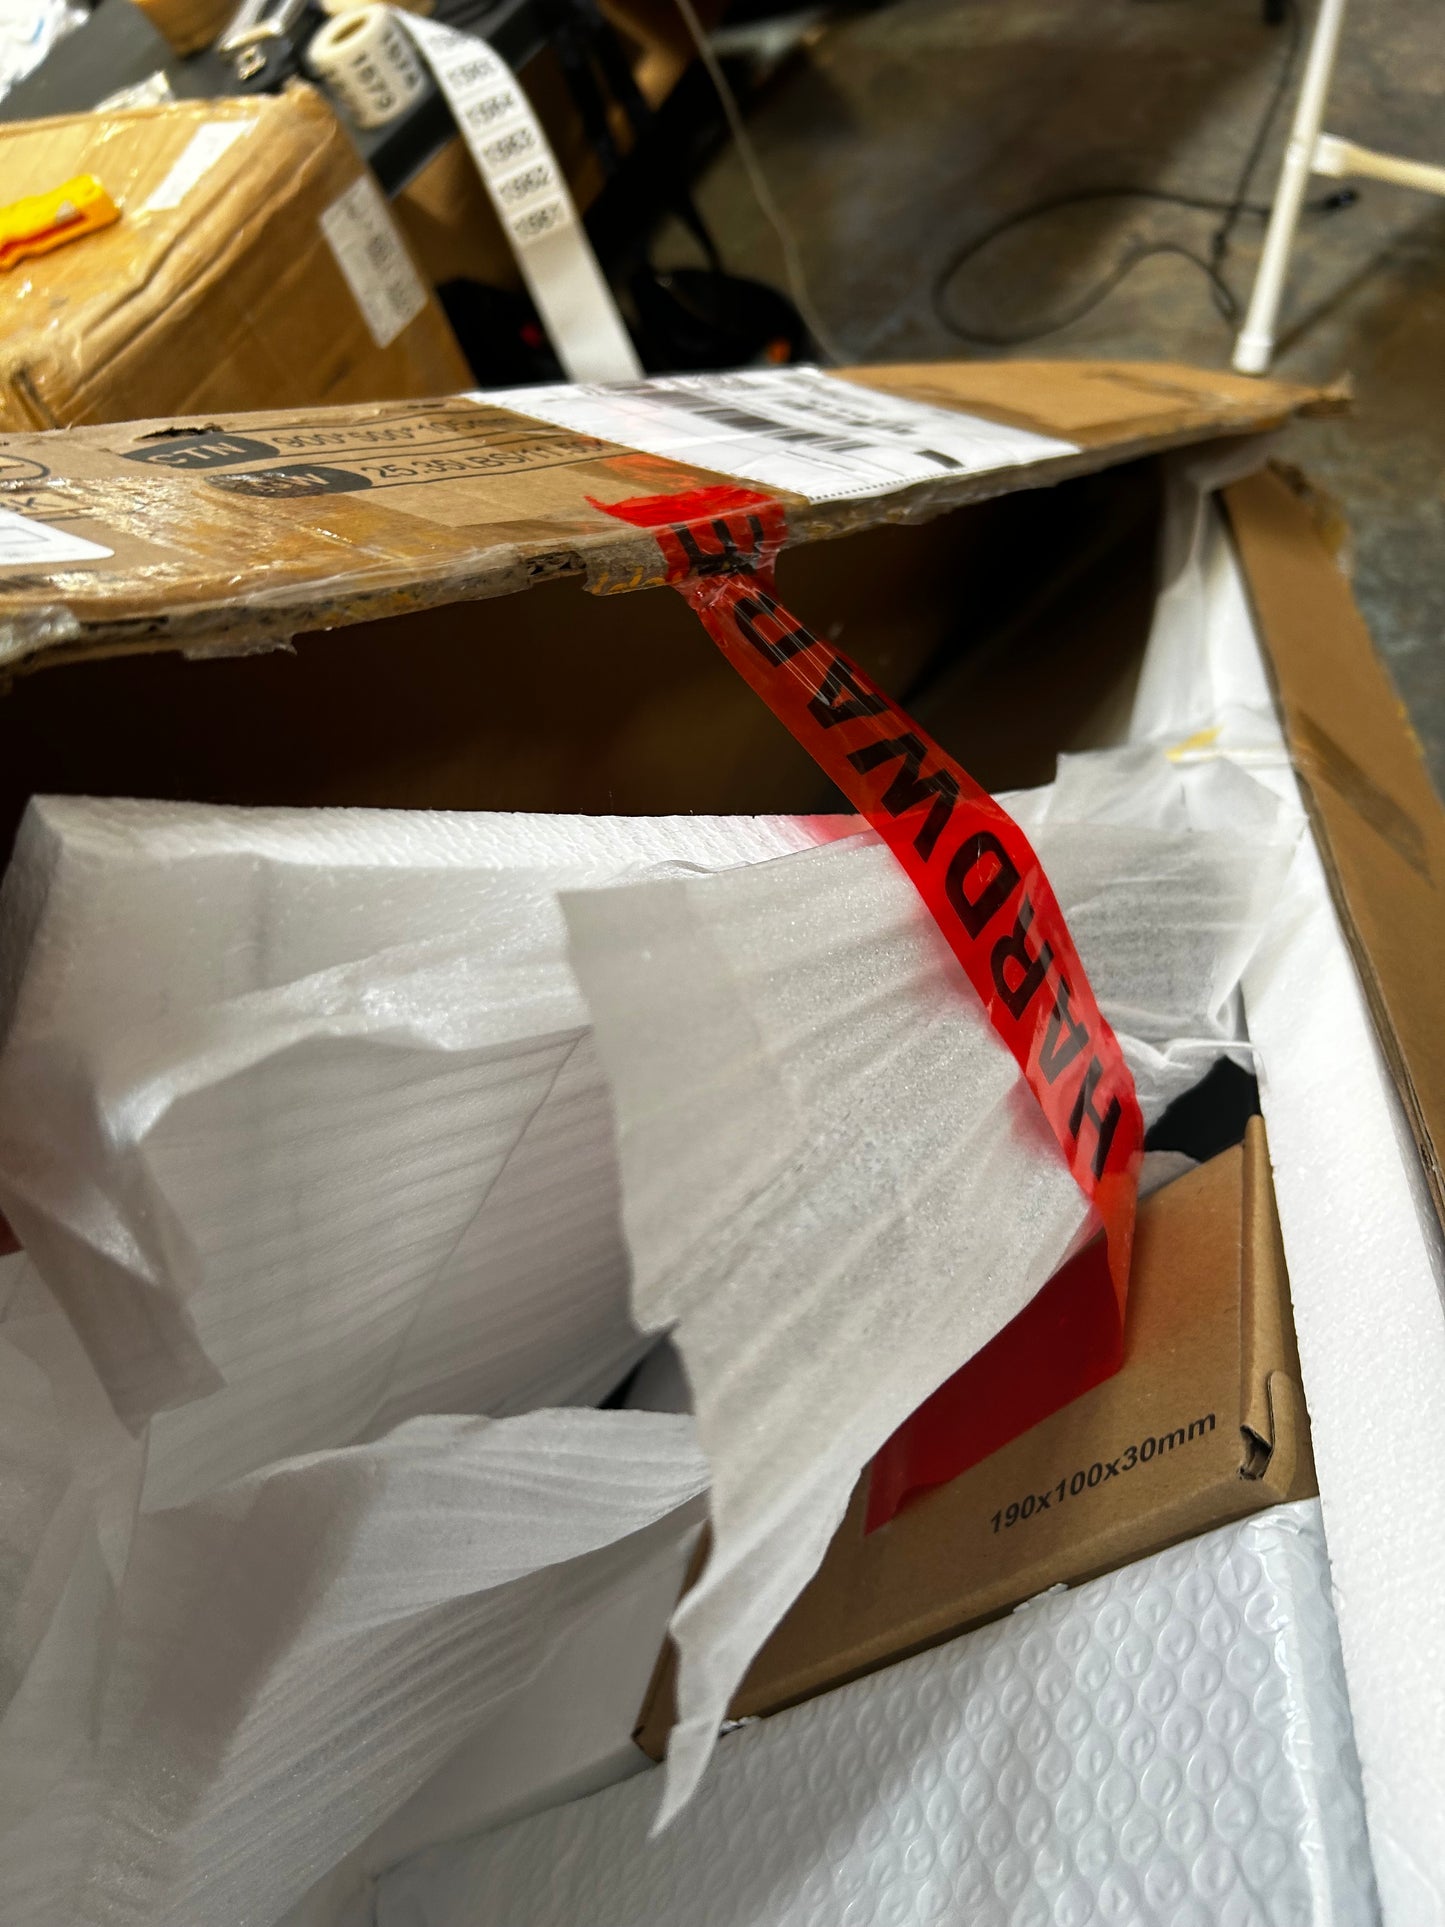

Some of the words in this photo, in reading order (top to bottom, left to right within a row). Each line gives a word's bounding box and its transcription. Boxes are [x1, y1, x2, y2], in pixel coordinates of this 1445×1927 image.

[147, 442, 246, 466] CTN
[669, 515, 1122, 1182] HARDWARE
[990, 1413, 1216, 1534] 190x100x30mm
